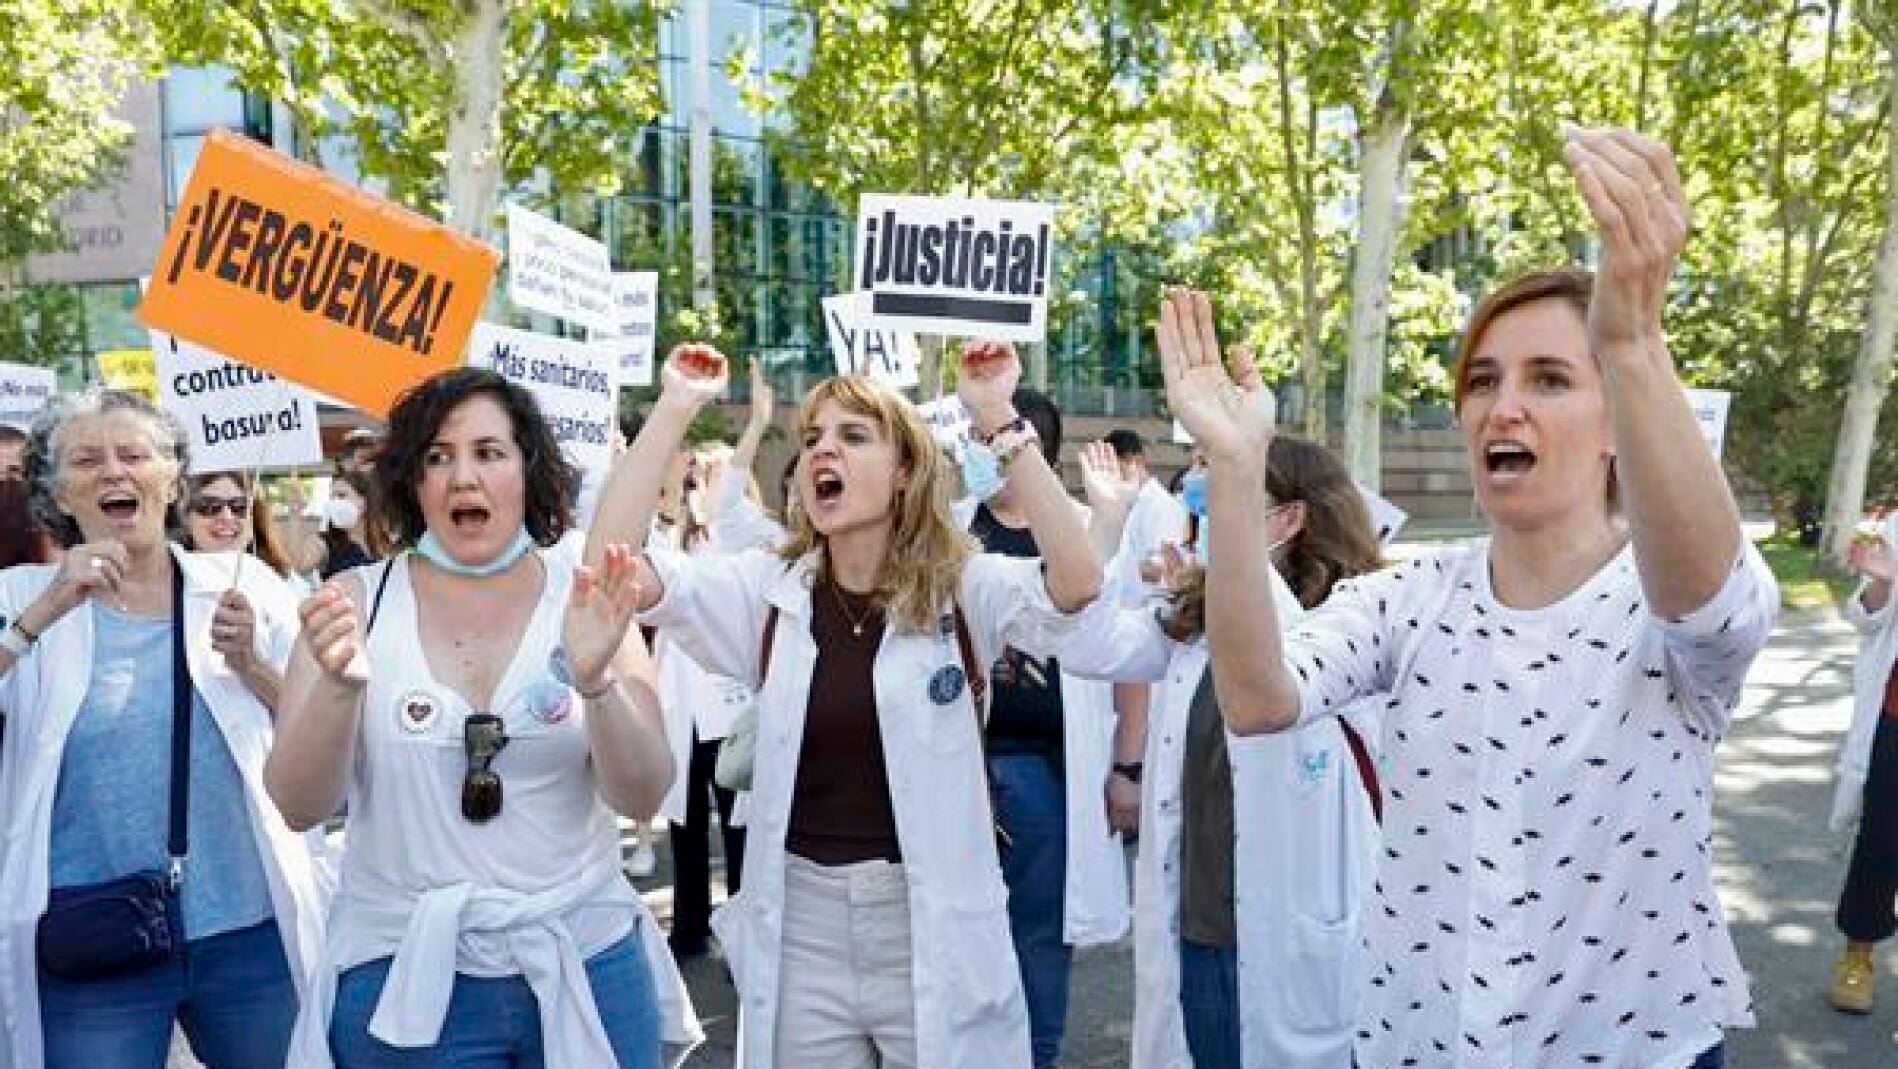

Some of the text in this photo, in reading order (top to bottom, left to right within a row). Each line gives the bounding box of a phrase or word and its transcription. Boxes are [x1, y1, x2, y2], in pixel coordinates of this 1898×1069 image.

[167, 186, 453, 356] ¡VERGÜENZA!
[861, 208, 1049, 298] ¡Justicia!
[831, 310, 902, 375] YA!
